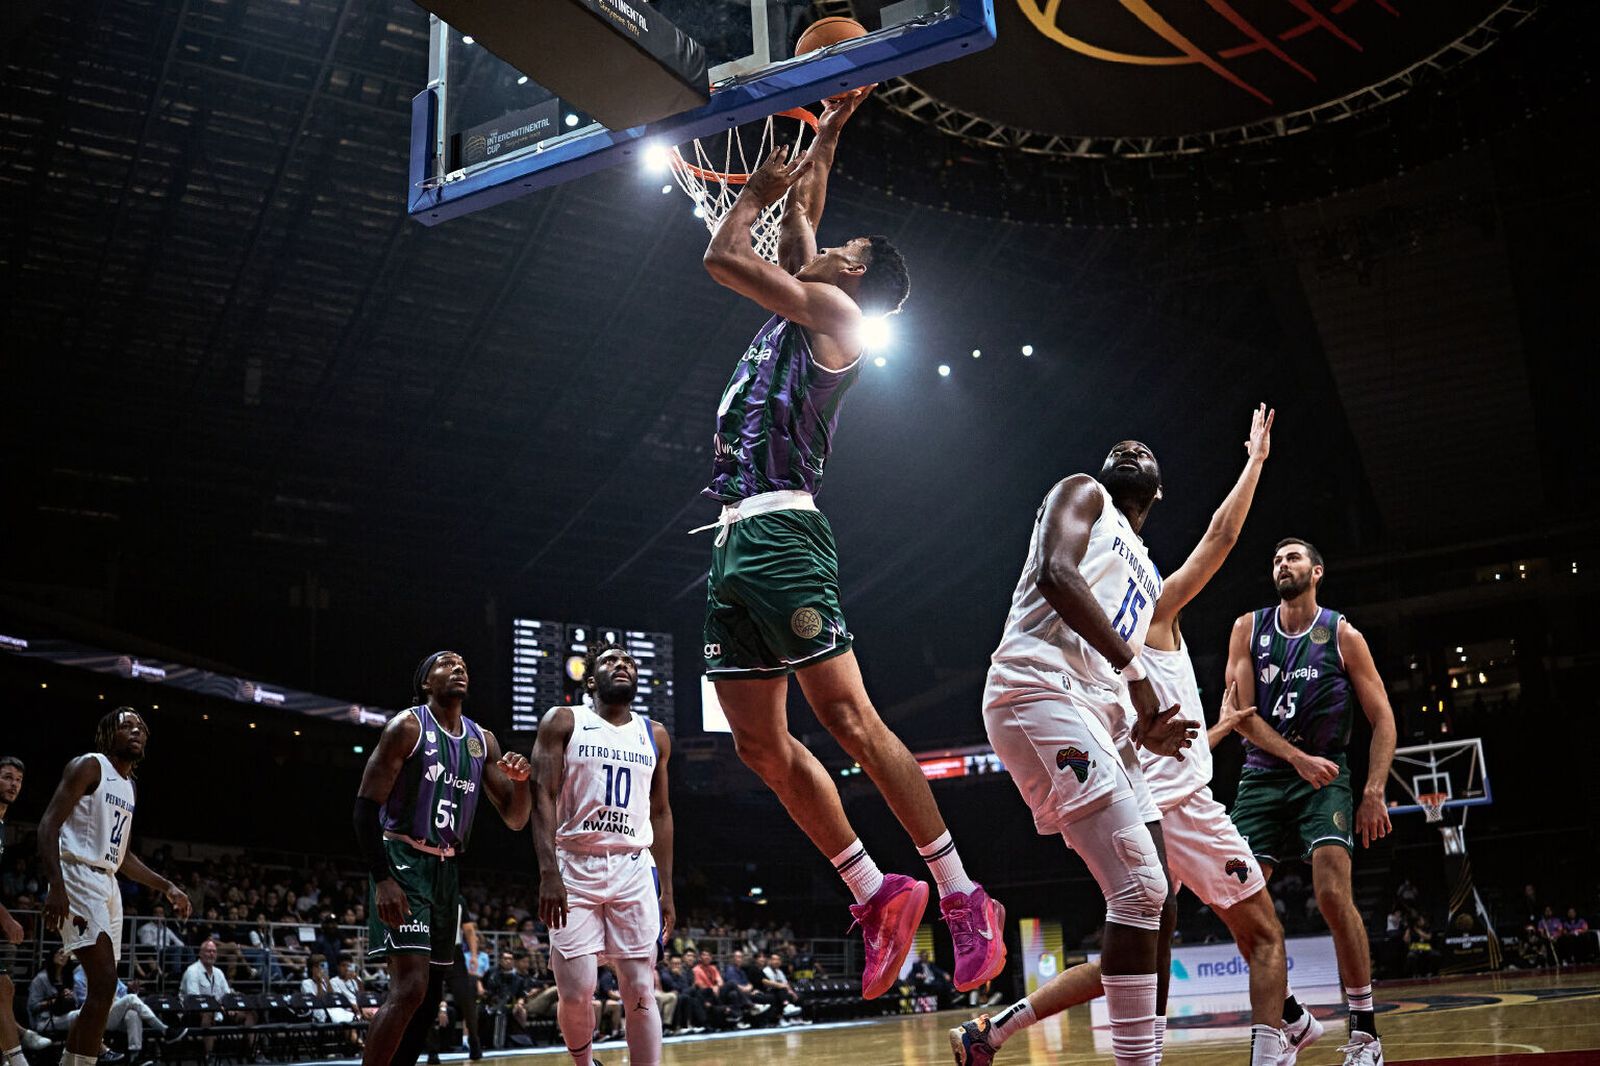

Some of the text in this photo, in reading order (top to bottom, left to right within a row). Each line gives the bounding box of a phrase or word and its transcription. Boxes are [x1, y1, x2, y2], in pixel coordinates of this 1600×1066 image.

[486, 118, 550, 147] INTERCONTINENTAL
[486, 143, 501, 155] CUP
[1112, 536, 1138, 571] PETRO
[1137, 564, 1145, 584] DE
[1112, 576, 1147, 643] 15
[1272, 692, 1298, 720] 45
[578, 744, 609, 759] PETRO
[443, 772, 476, 795] Uicaja
[602, 763, 632, 809] 10
[110, 810, 127, 847] 24
[434, 799, 458, 832] 55
[583, 821, 636, 837] RWANDA
[597, 810, 629, 824] VISIT
